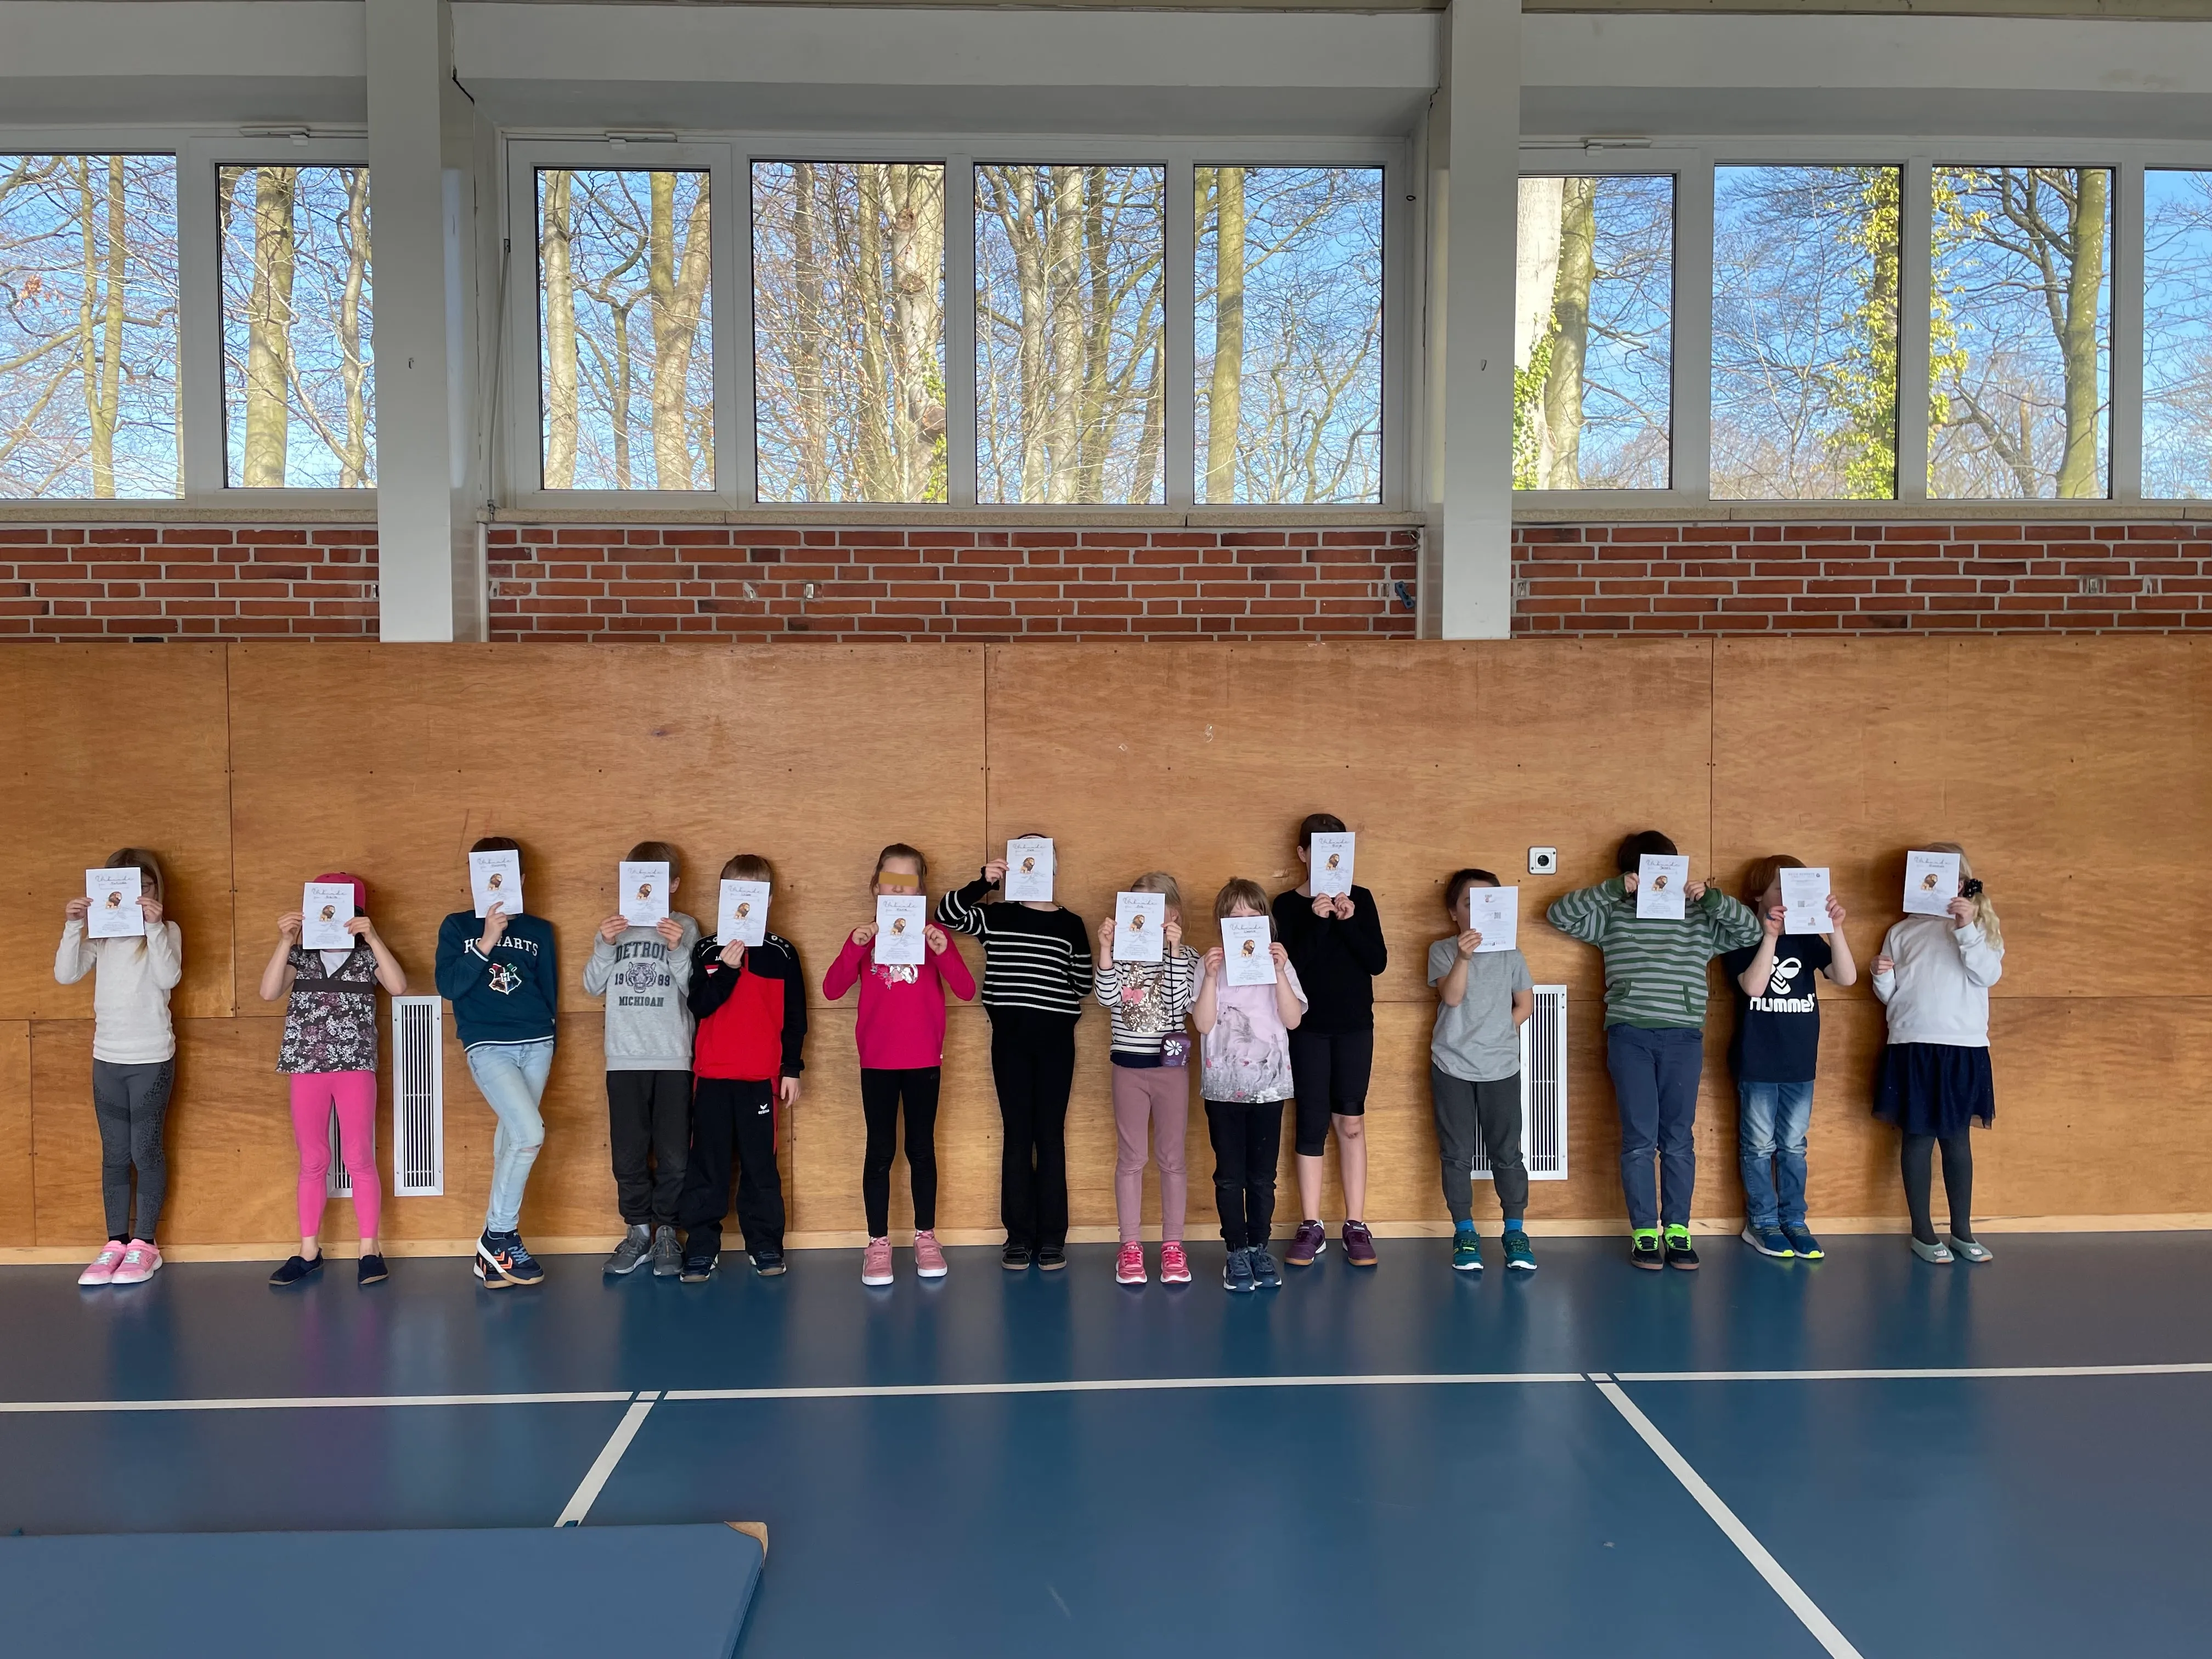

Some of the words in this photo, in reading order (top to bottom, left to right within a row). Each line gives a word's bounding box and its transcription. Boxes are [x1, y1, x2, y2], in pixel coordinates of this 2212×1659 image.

[464, 936, 538, 956] HARTS
[614, 941, 666, 964] DETROI
[614, 973, 624, 985] 19
[658, 974, 670, 986] 89
[619, 996, 664, 1007] MICHIGAN
